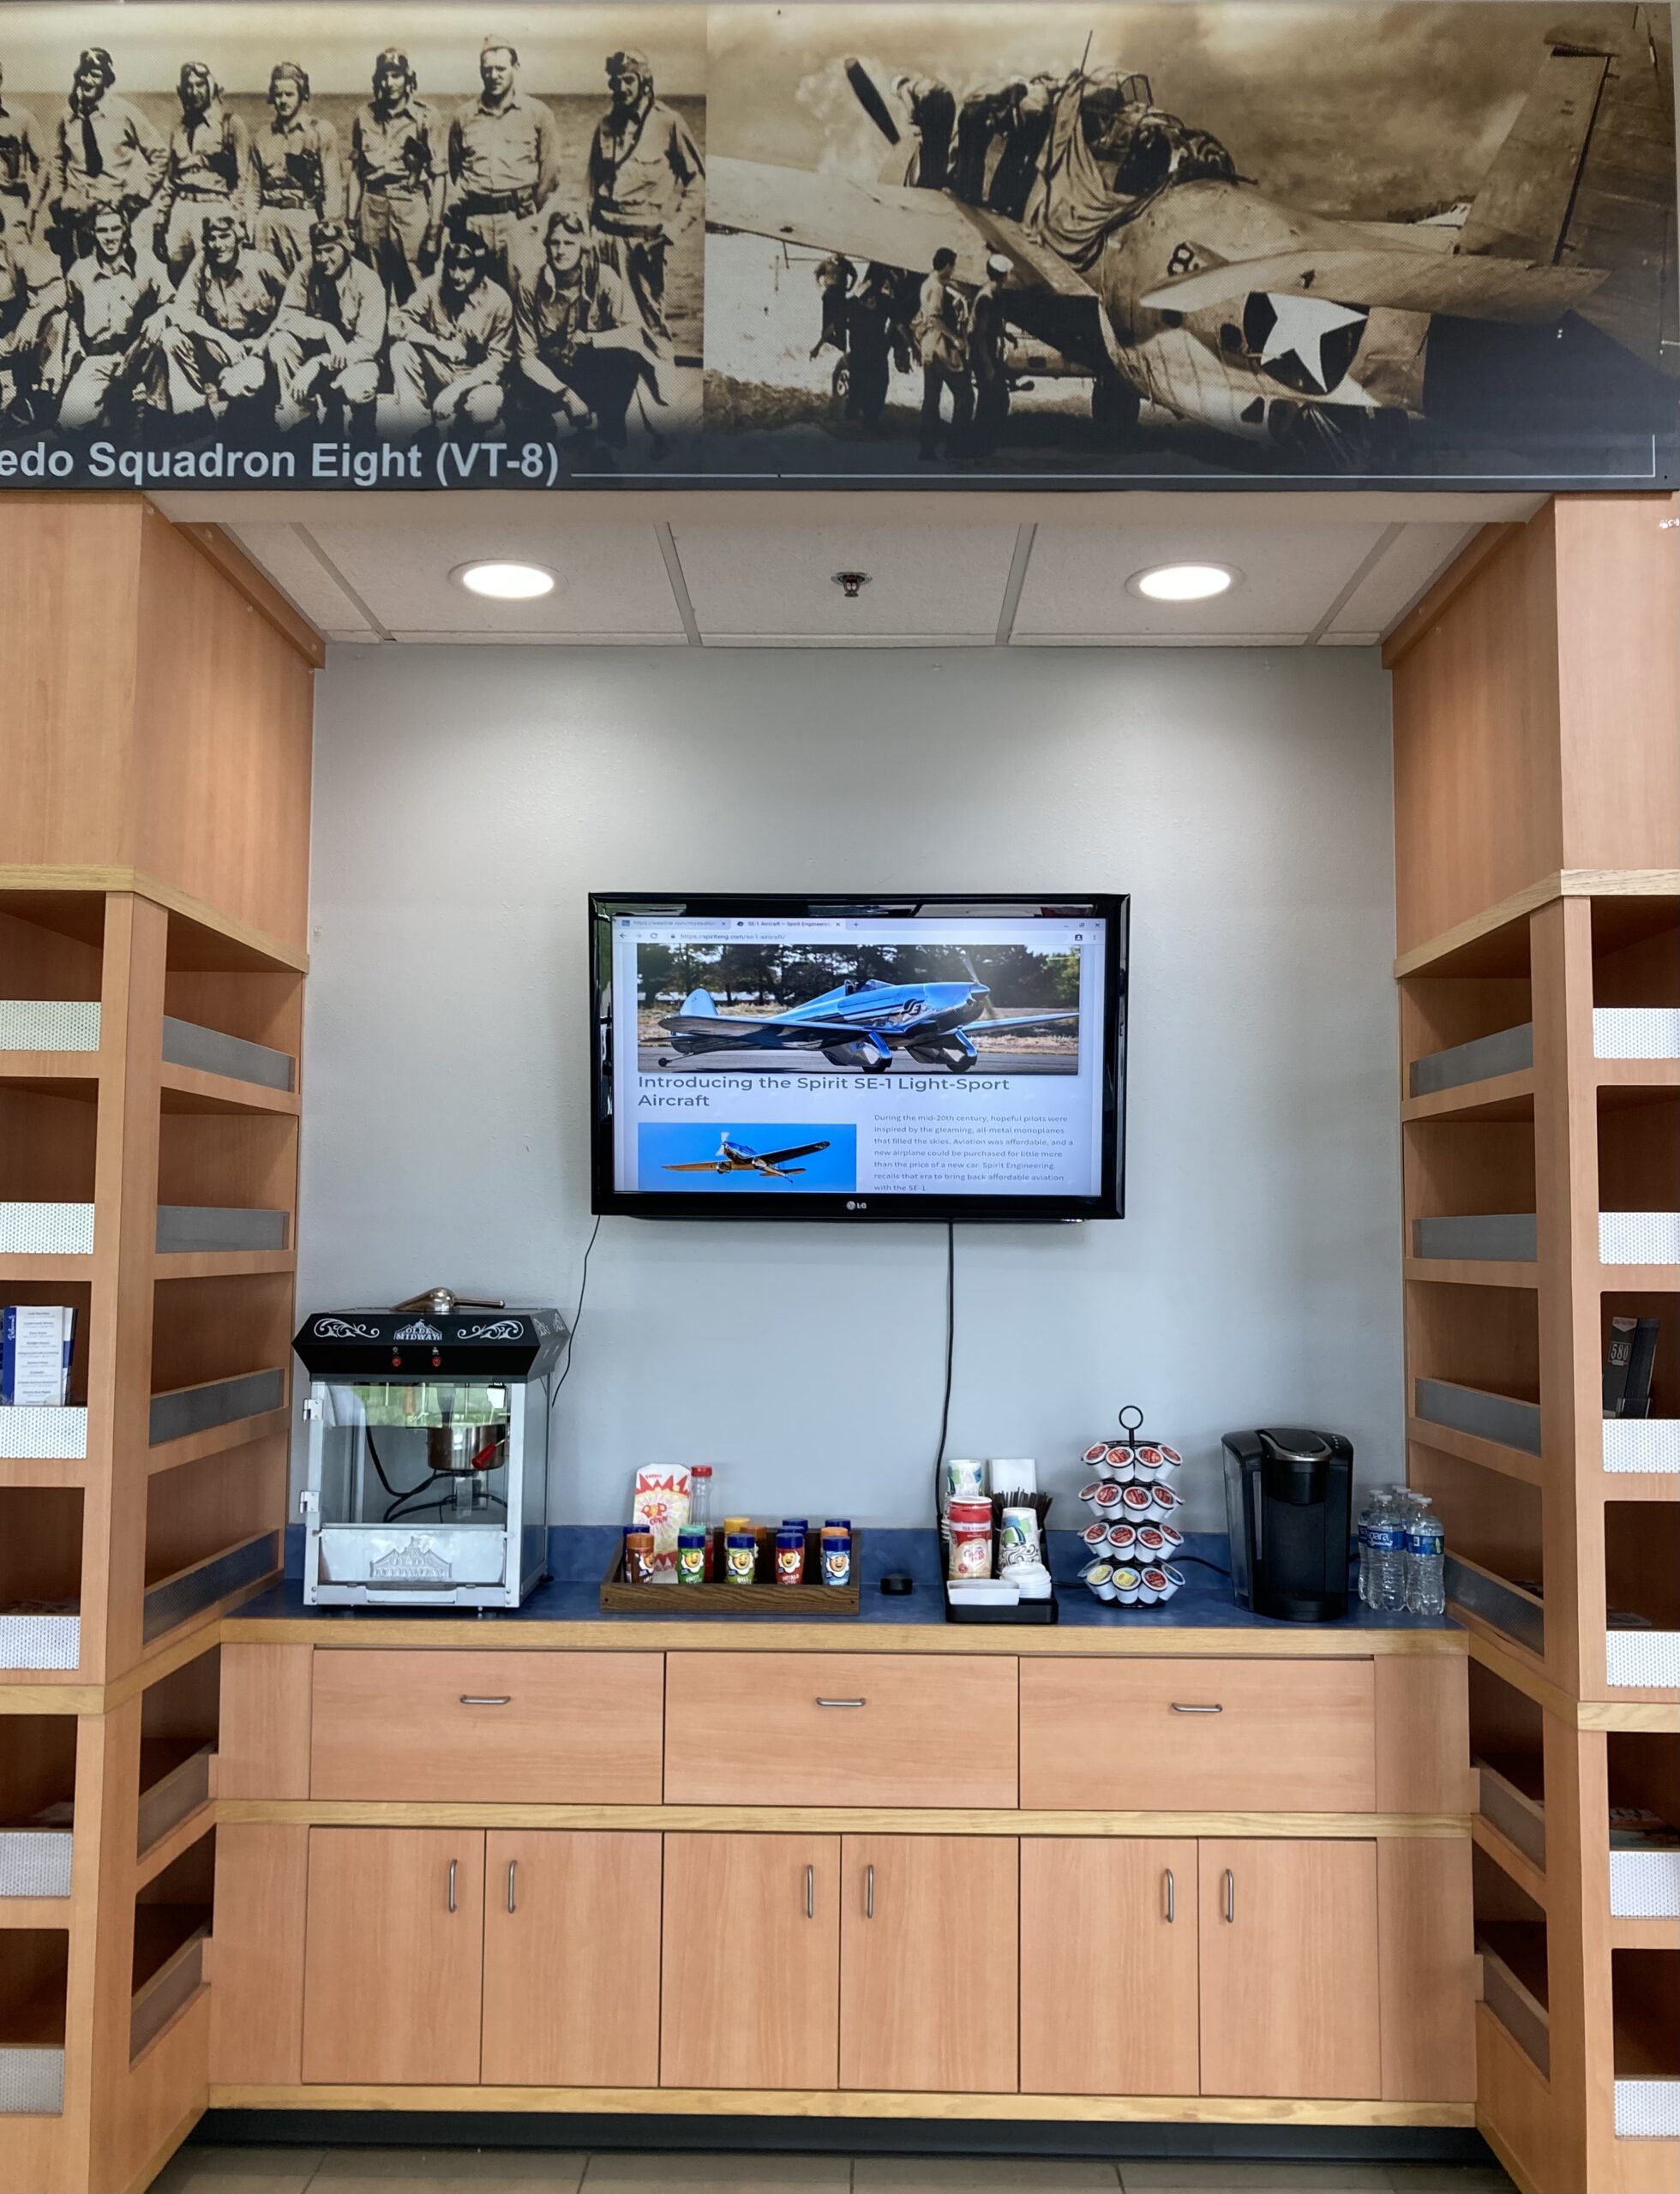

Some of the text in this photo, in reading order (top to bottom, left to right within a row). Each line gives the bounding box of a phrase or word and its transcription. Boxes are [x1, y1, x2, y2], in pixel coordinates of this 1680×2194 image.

[0, 441, 559, 486] edo Squadron Eight (VT-8)
[638, 1076, 1011, 1092] Introducing the Spirit SE-1 Light-Sport
[638, 1094, 710, 1106] Aircraft
[1611, 1343, 1629, 1361] 580
